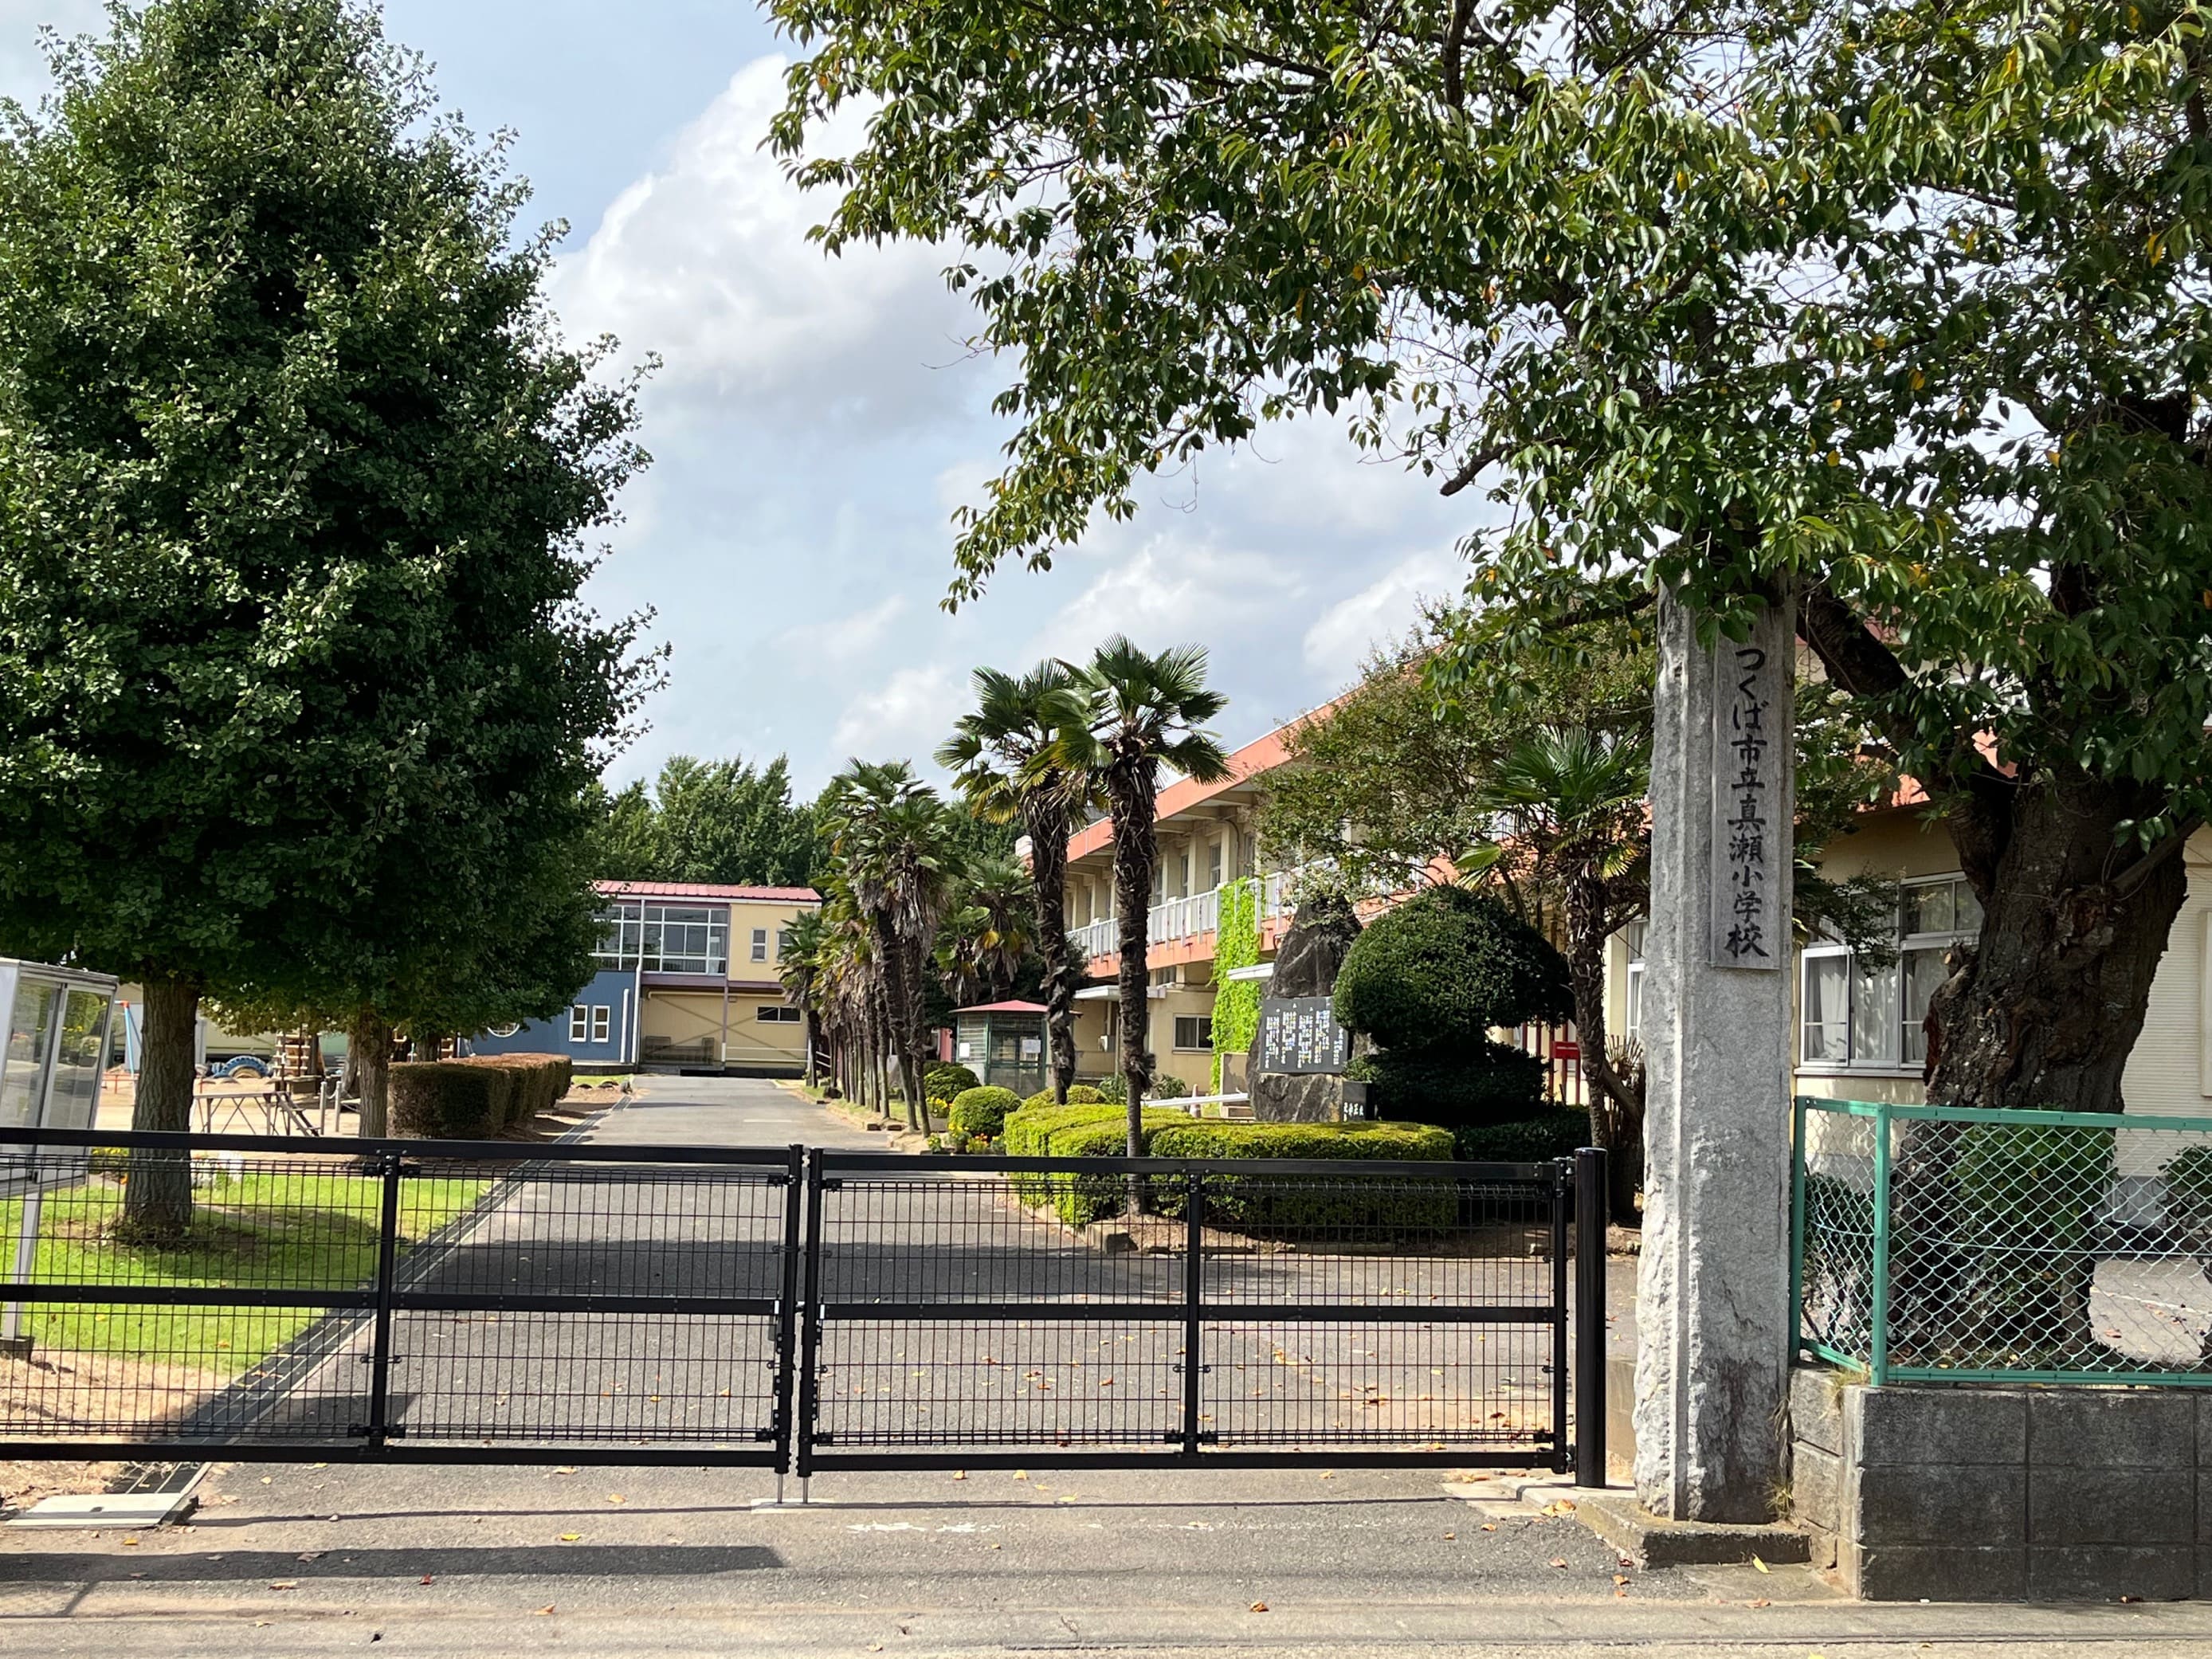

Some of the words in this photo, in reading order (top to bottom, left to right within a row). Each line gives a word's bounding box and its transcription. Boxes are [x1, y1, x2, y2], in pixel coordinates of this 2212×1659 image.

[1724, 647, 1770, 958] つくば市立真瀬小学校
